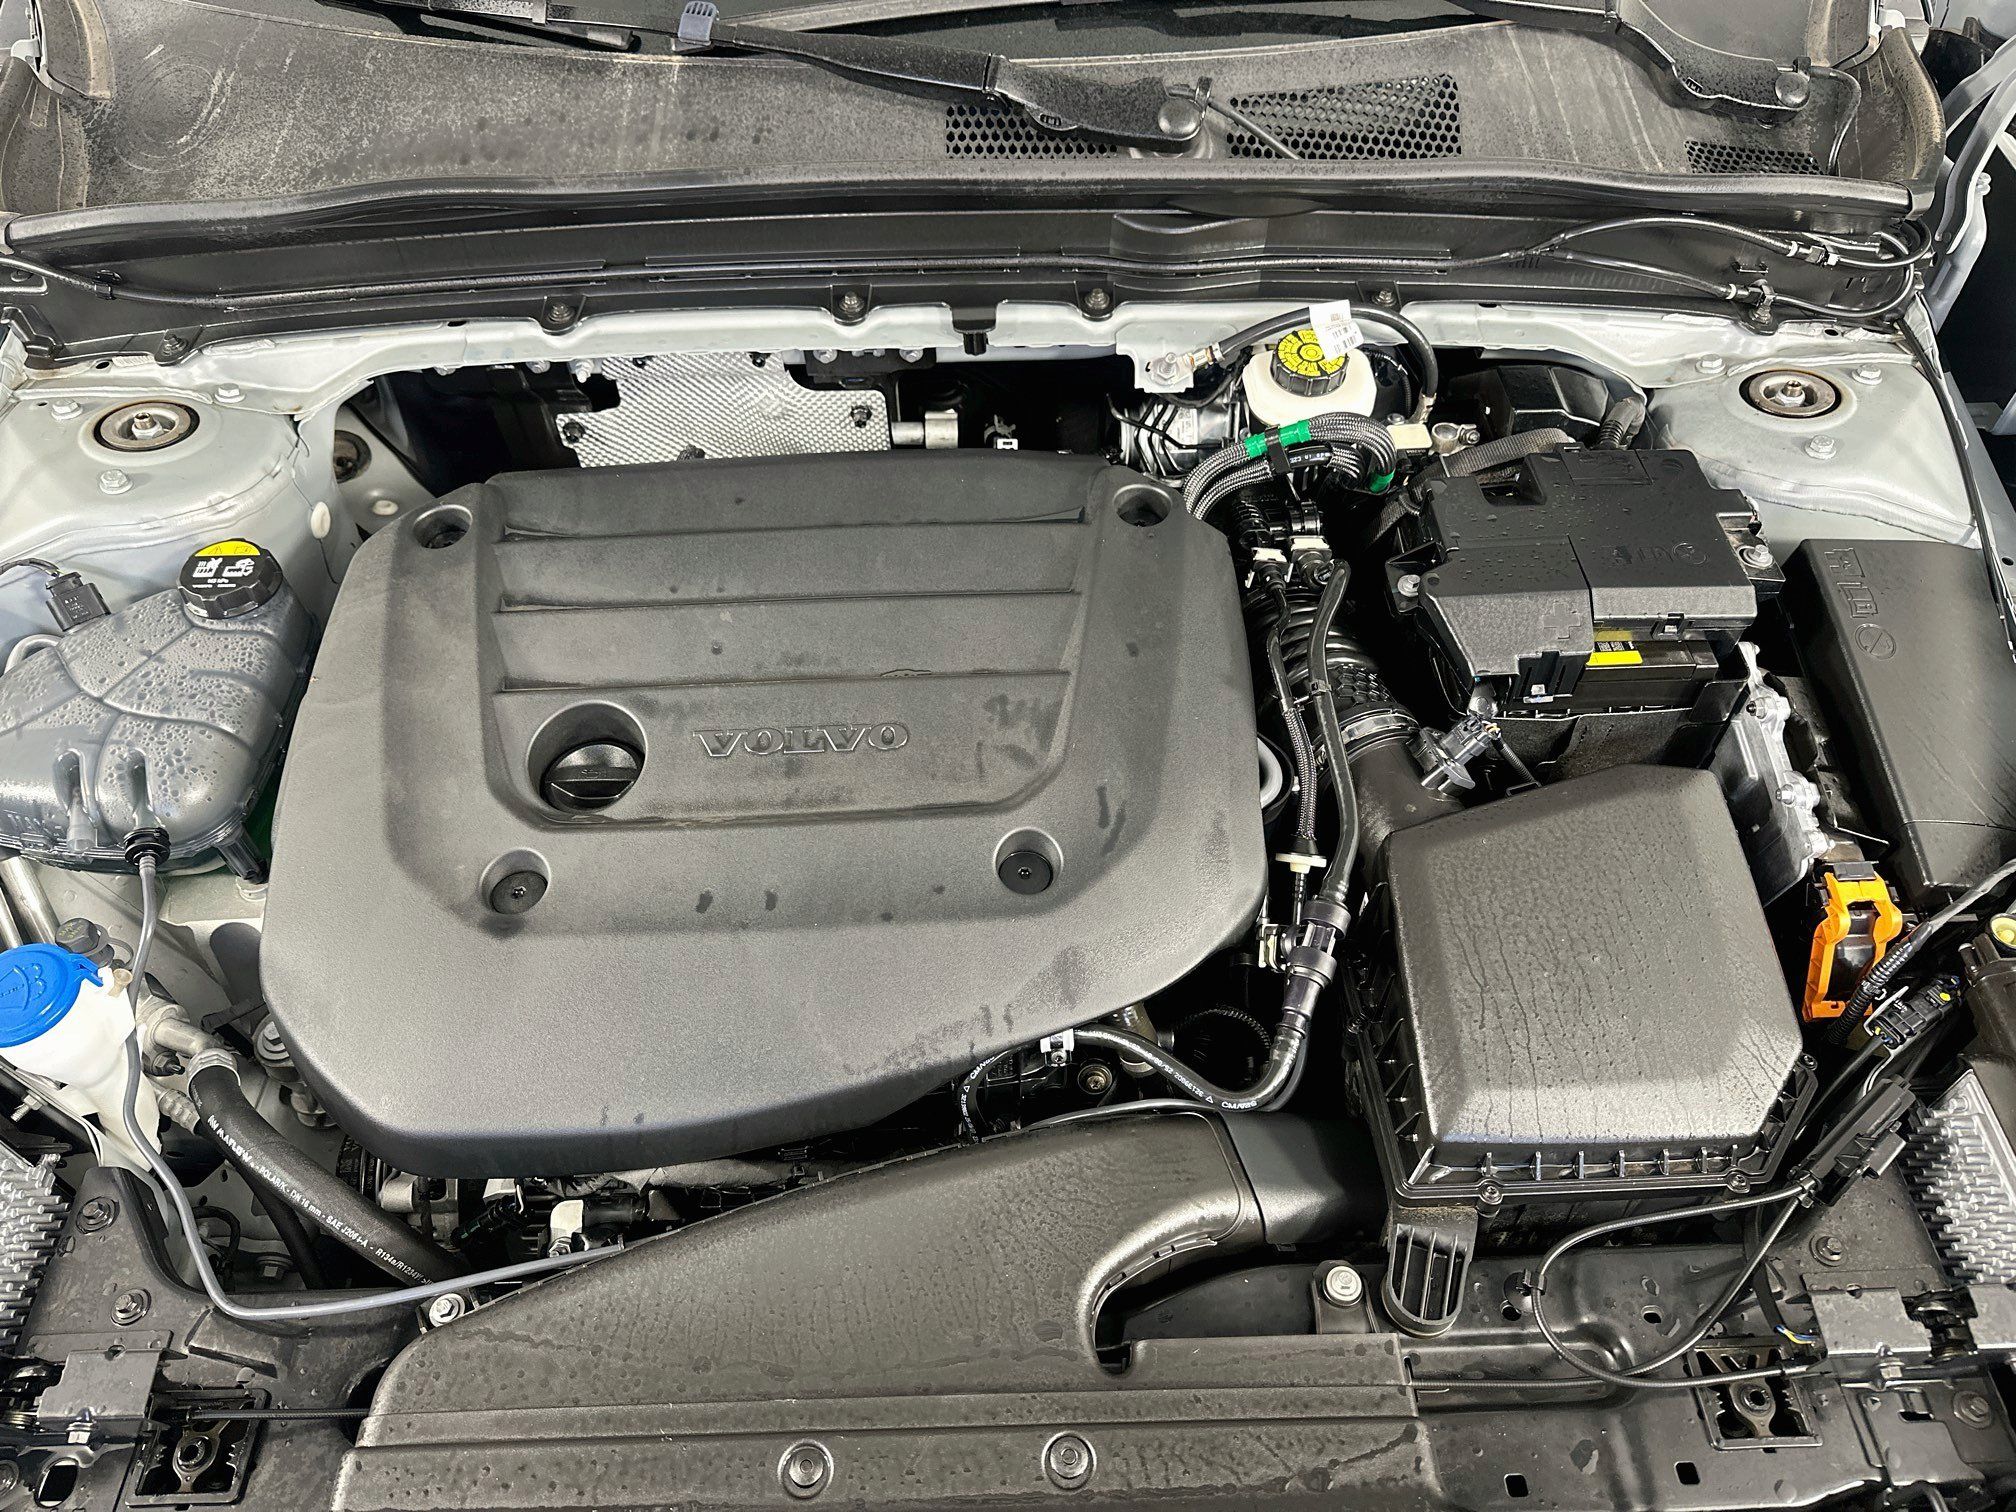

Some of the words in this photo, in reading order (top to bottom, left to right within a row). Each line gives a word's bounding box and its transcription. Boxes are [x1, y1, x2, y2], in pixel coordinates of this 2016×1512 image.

[692, 722, 909, 758] VOLVO
[308, 1204, 322, 1217] mm
[326, 1215, 343, 1230] SAE
